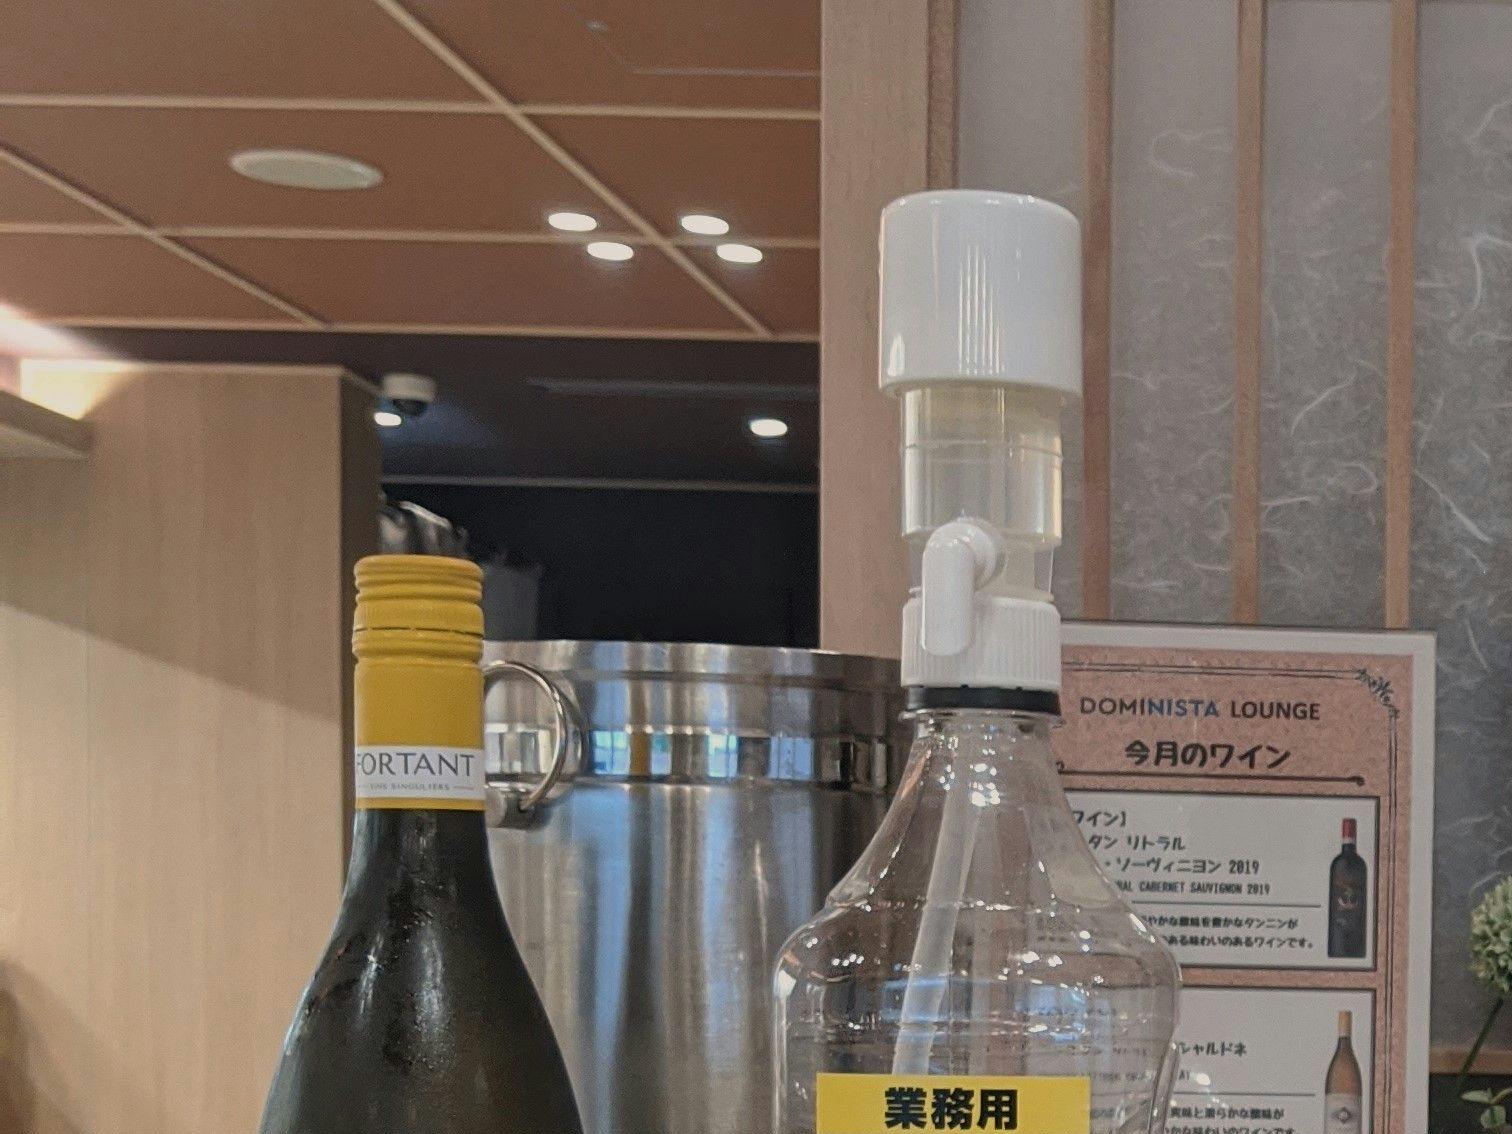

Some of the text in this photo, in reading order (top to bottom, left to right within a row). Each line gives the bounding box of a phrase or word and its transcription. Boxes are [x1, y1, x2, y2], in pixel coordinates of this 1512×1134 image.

[1079, 697, 1321, 721] DOMINISTA LOUNGE
[1125, 740, 1291, 769] 今月のワイン
[1127, 836, 1186, 851] リトラル
[1229, 860, 1260, 874] 2019
[1140, 881, 1184, 893] CABERNET
[1190, 882, 1242, 894] SAUVIGNON
[1247, 883, 1270, 895] 2019
[885, 1087, 1018, 1130] 業務用
